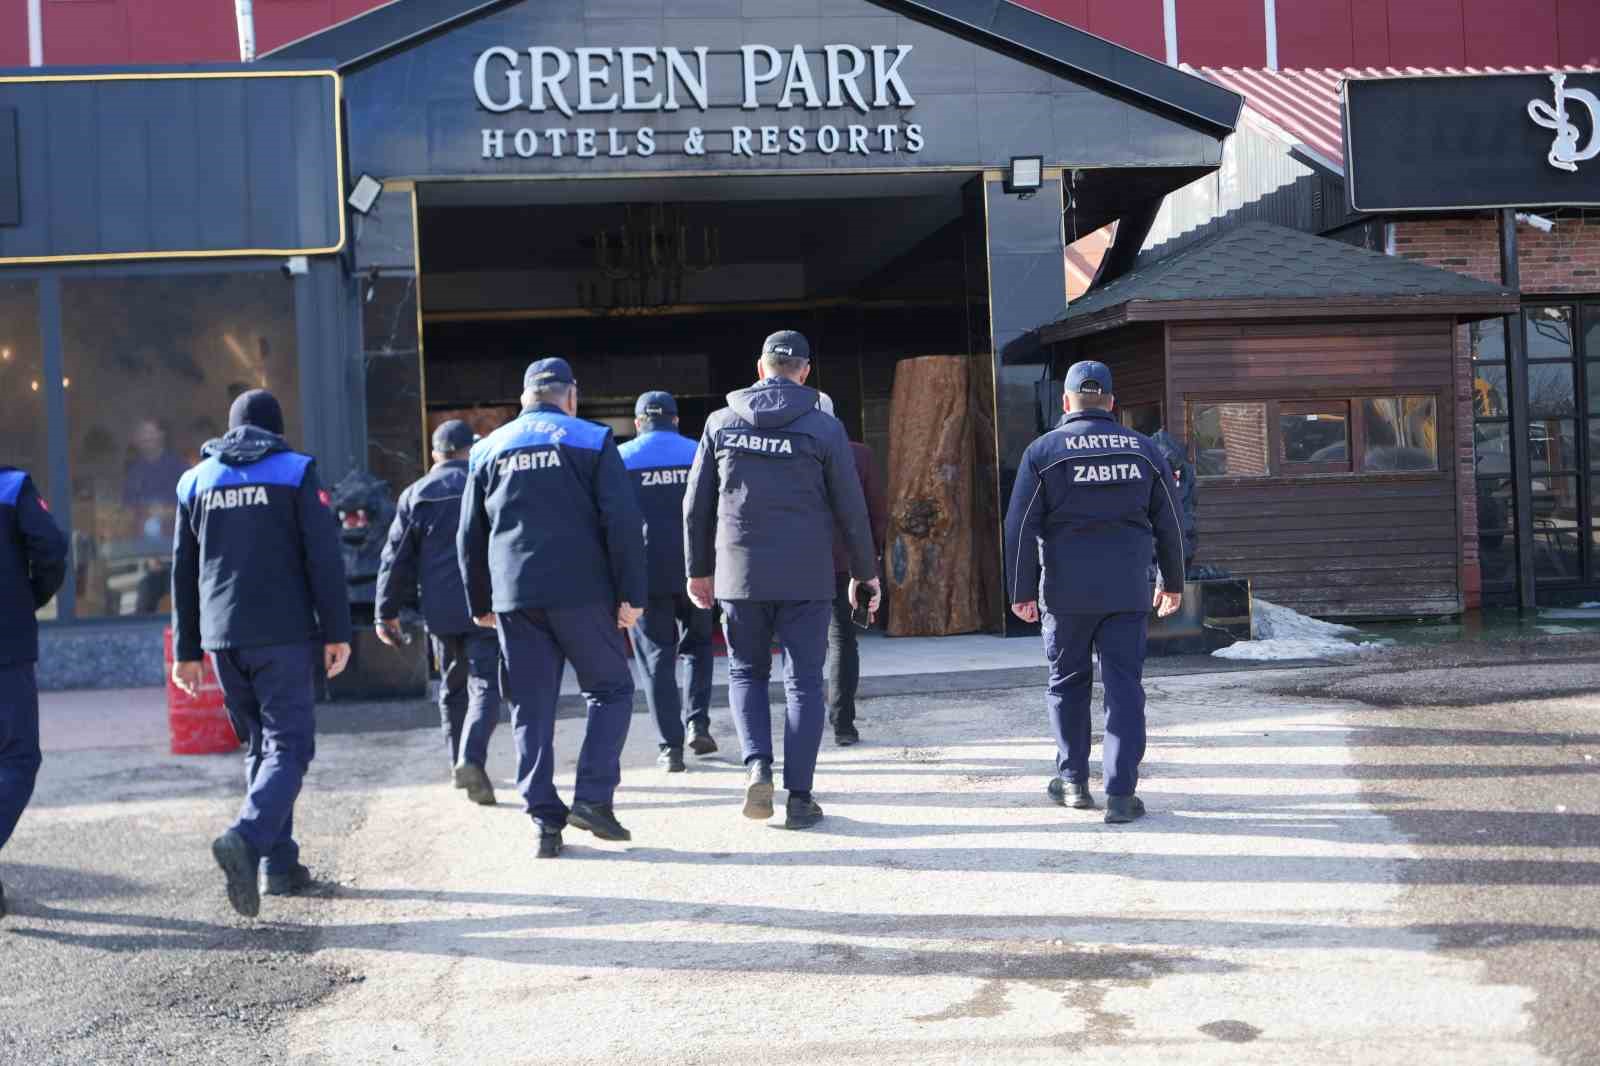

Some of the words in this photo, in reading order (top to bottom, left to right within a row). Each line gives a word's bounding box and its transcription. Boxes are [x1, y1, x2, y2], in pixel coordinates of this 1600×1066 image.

[473, 46, 709, 117] GREEN
[740, 44, 916, 111] PARK
[481, 127, 657, 158] HOTELS
[683, 128, 705, 155] &
[731, 125, 925, 156] RESORTS
[723, 432, 793, 454] ZABITA
[1065, 436, 1140, 450] KARTEPE
[496, 450, 561, 475] ZABITA
[1073, 463, 1142, 483] ZABITA
[641, 470, 691, 486] ZABIT
